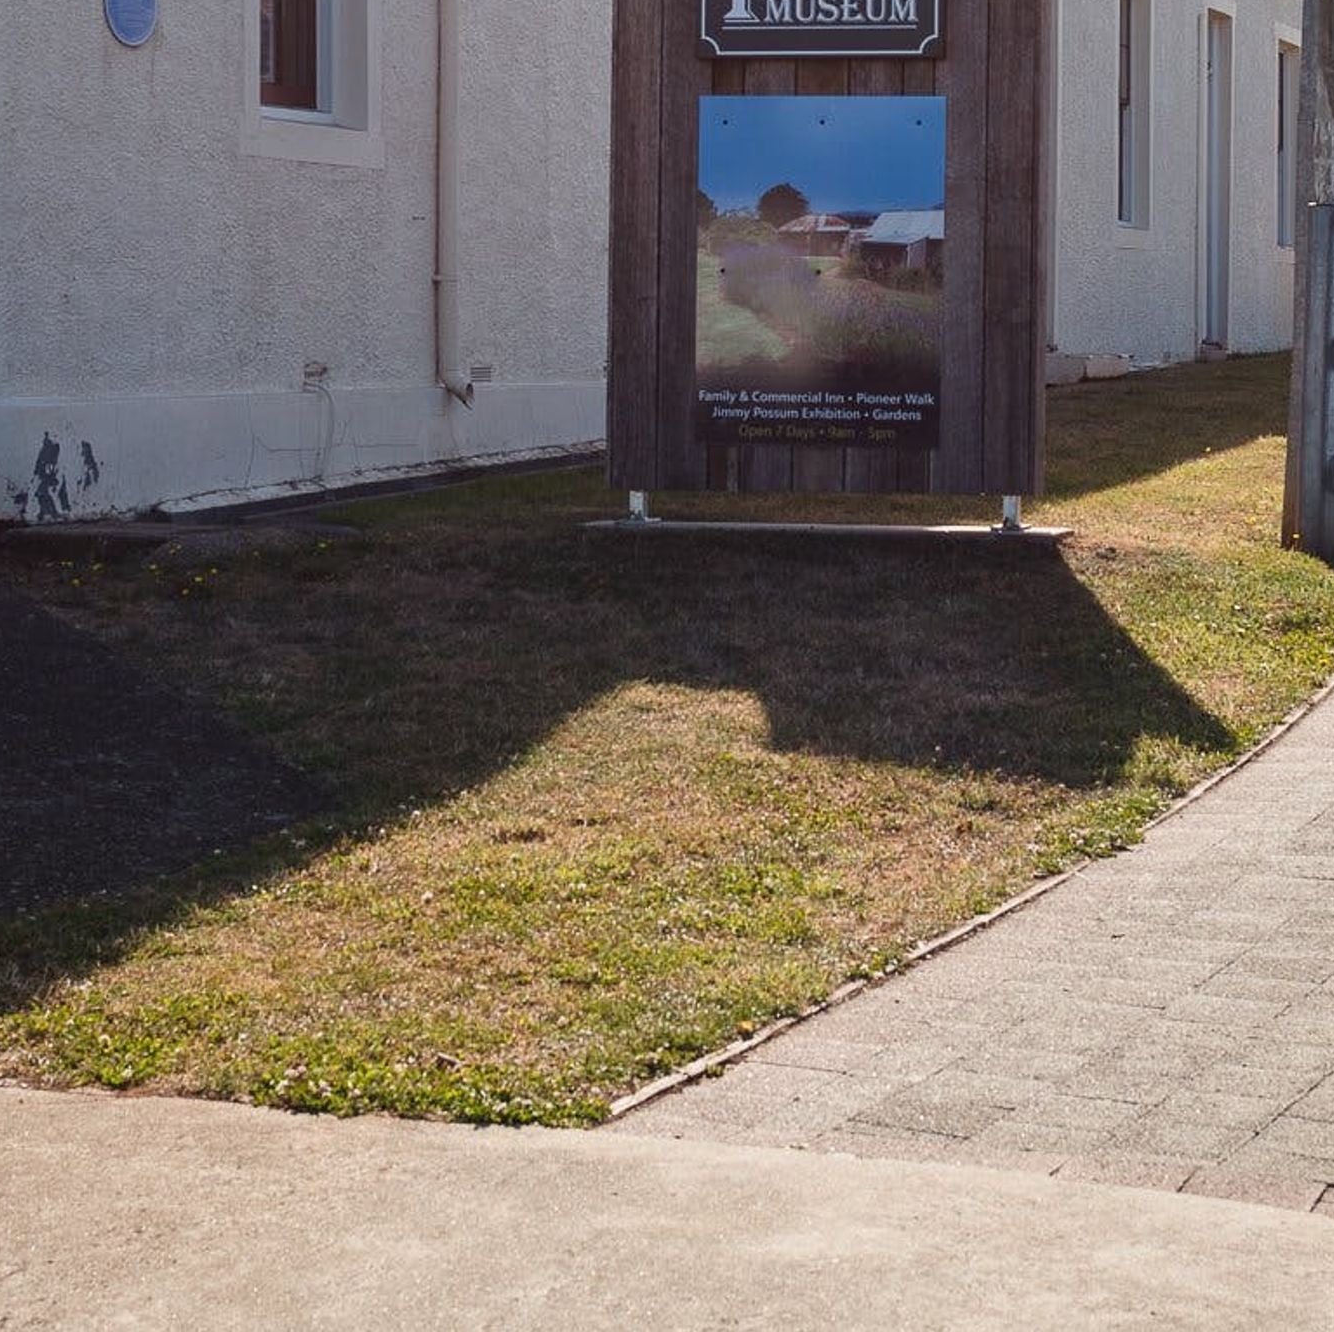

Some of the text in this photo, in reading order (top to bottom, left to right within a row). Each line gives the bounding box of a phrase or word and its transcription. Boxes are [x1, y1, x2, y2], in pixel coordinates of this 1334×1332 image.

[698, 390, 935, 405] Family & Commercial Inn Pioneer Walk
[712, 407, 922, 421] Jimmy Possum Exhibition Gardens
[739, 425, 772, 440] Open
